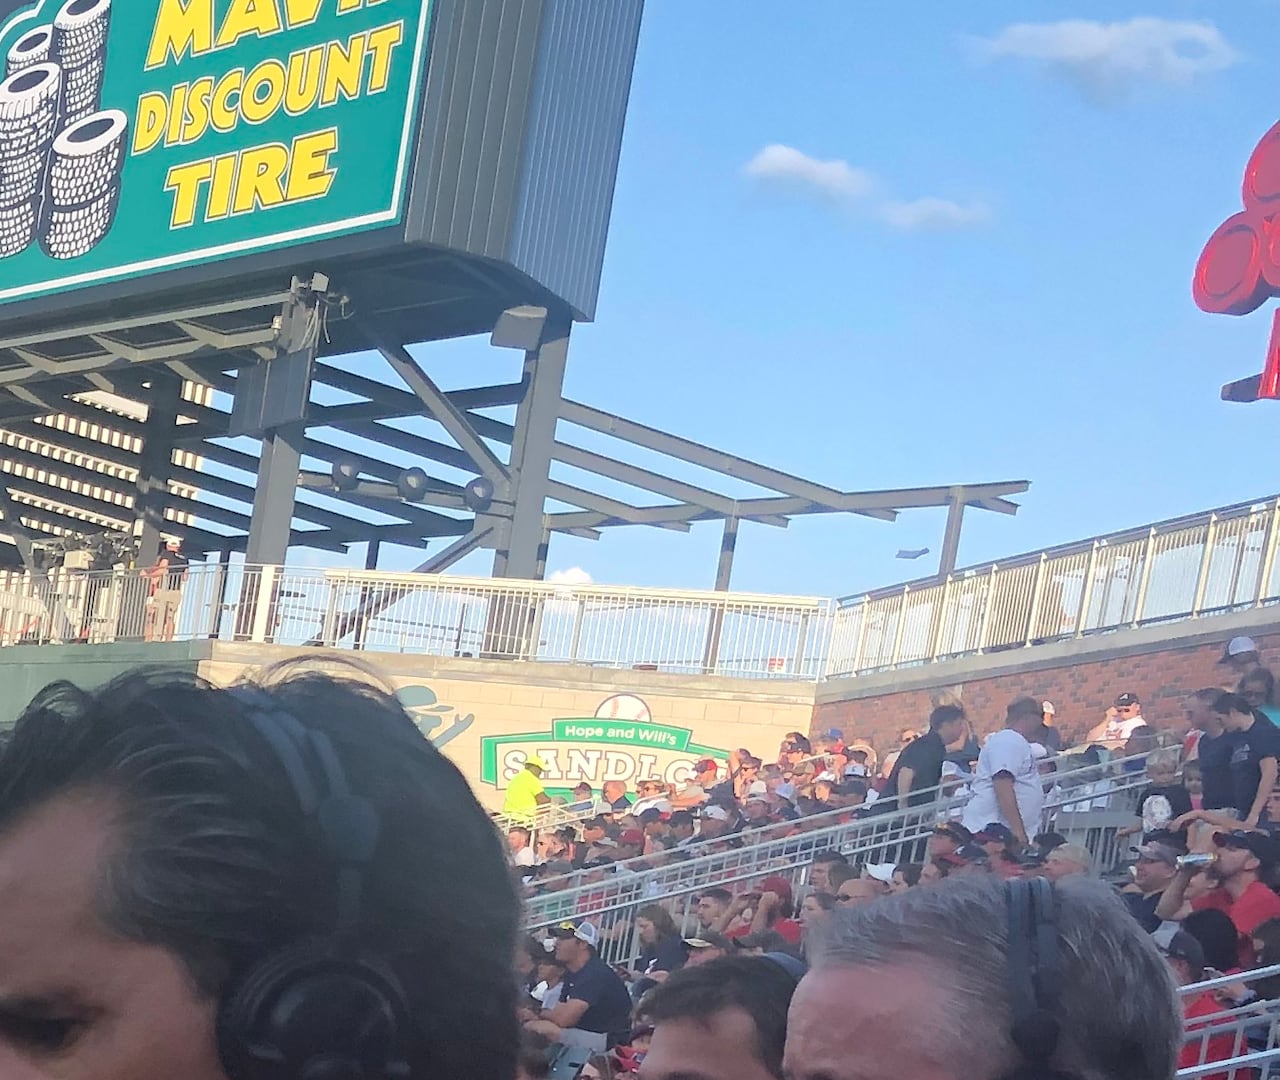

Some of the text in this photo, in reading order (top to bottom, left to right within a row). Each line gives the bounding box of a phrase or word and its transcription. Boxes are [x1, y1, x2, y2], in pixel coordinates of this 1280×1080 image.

[132, 21, 402, 154] DISCOUNT
[164, 127, 338, 229] TIRE
[503, 748, 727, 791] SANDLO
[564, 725, 677, 747] Hope and Will's
